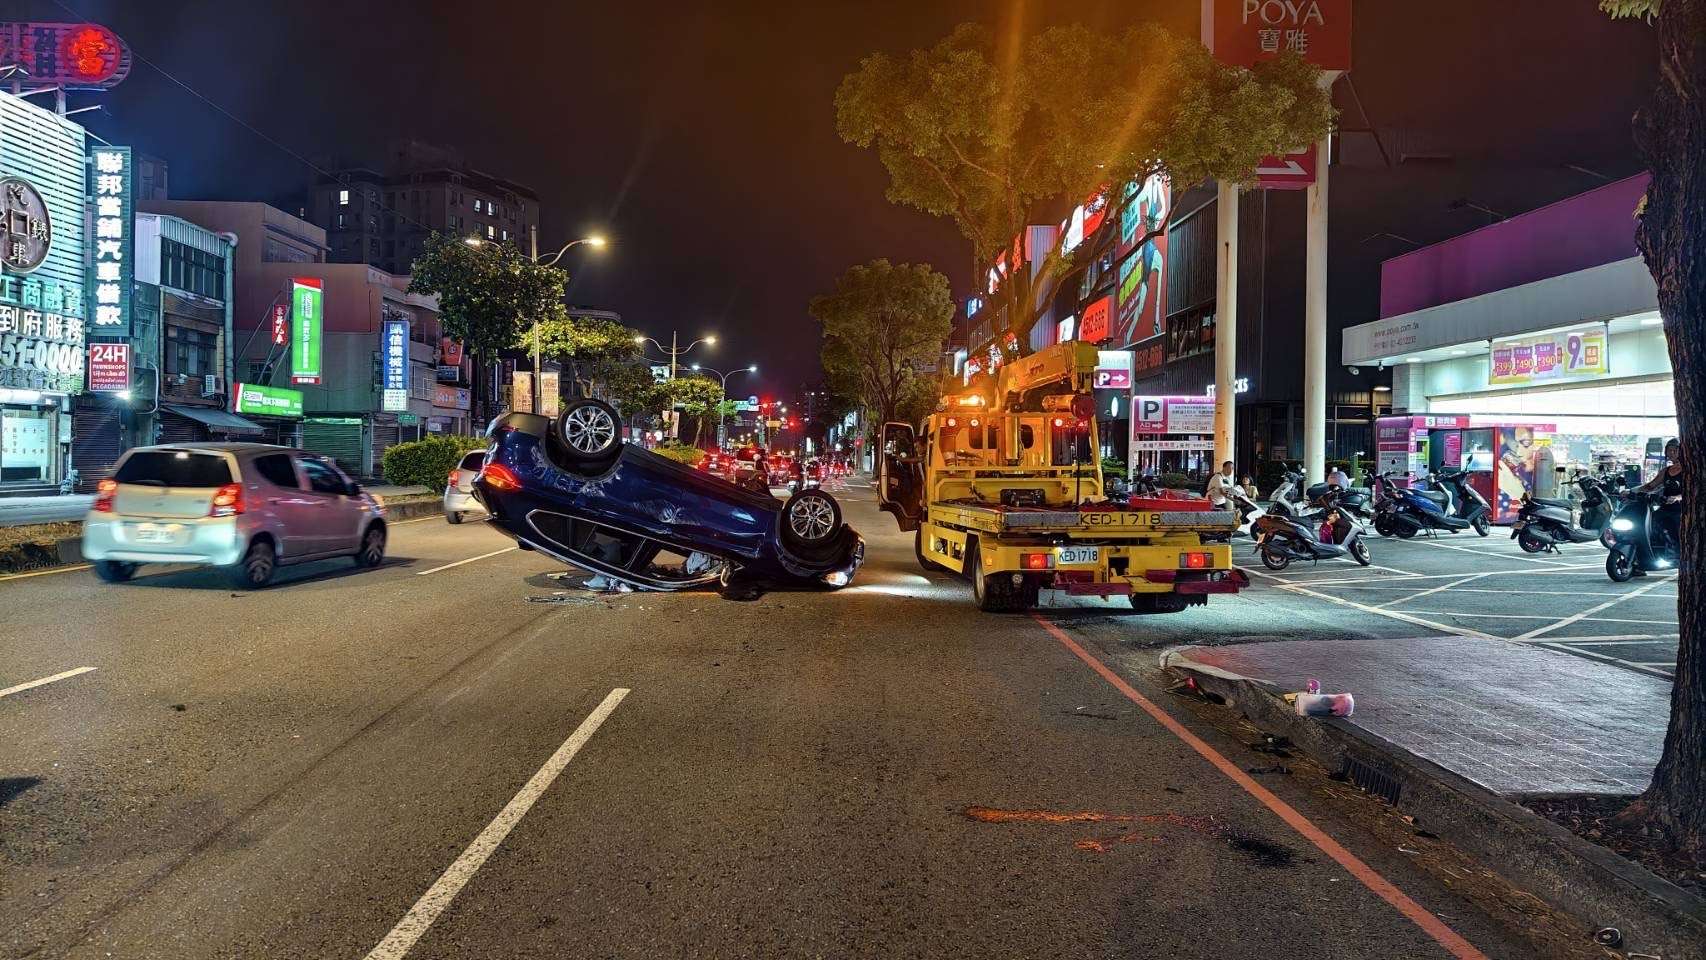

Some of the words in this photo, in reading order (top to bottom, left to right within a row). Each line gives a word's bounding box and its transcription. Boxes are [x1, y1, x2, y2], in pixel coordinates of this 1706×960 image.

[1242, 0, 1325, 25] POYA
[1258, 28, 1309, 54] 寶雅
[96, 152, 123, 325] 聯邦當舖汽車借款
[0, 306, 83, 343] 到府服務
[93, 346, 126, 362] 24H
[1099, 372, 1111, 386] P
[1144, 401, 1159, 419] P
[1080, 513, 1161, 525] KED-1718
